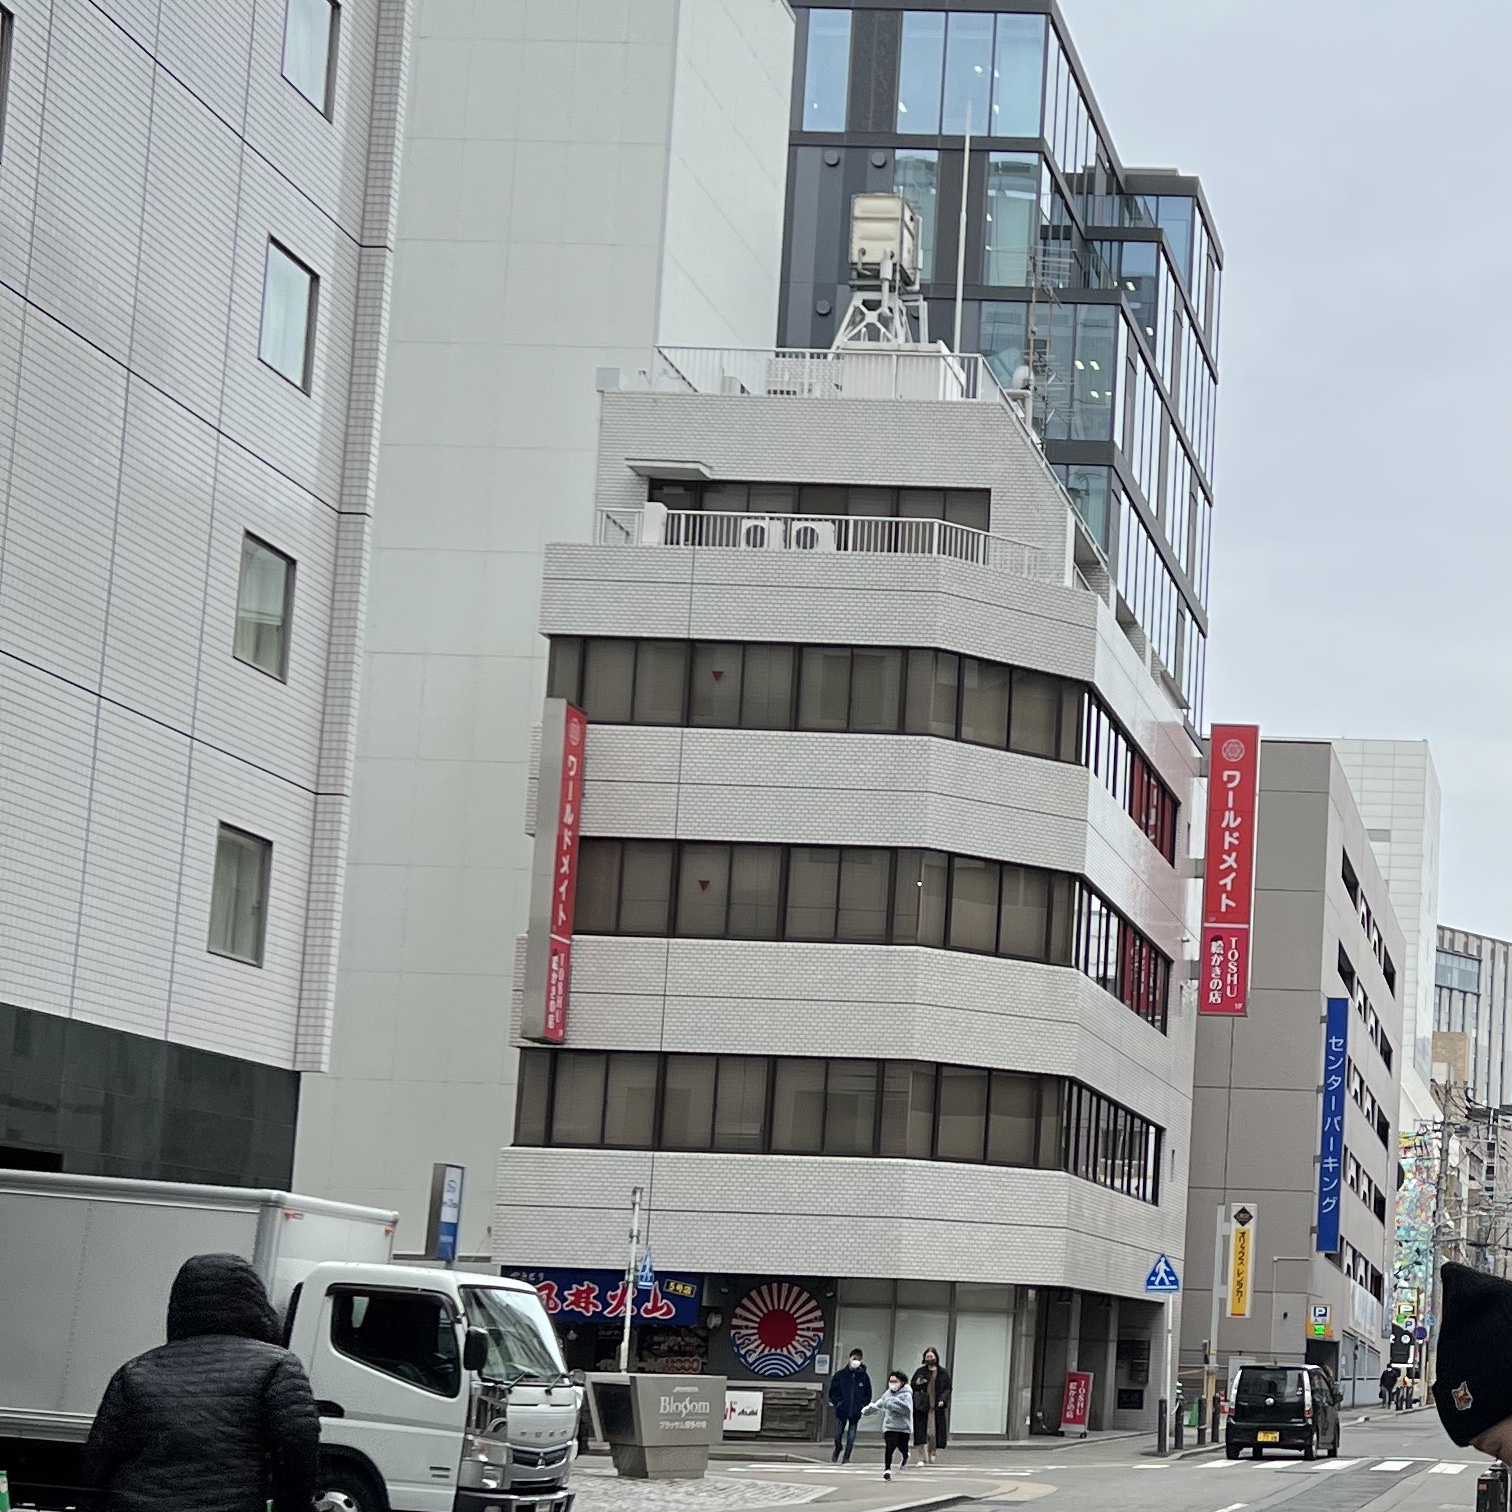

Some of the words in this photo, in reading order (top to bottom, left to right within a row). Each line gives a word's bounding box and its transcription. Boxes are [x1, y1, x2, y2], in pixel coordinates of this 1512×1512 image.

[1218, 770, 1242, 913] ワールドメイト
[1226, 937, 1239, 998] TOSHU
[1321, 1036, 1344, 1213] センターパーキング
